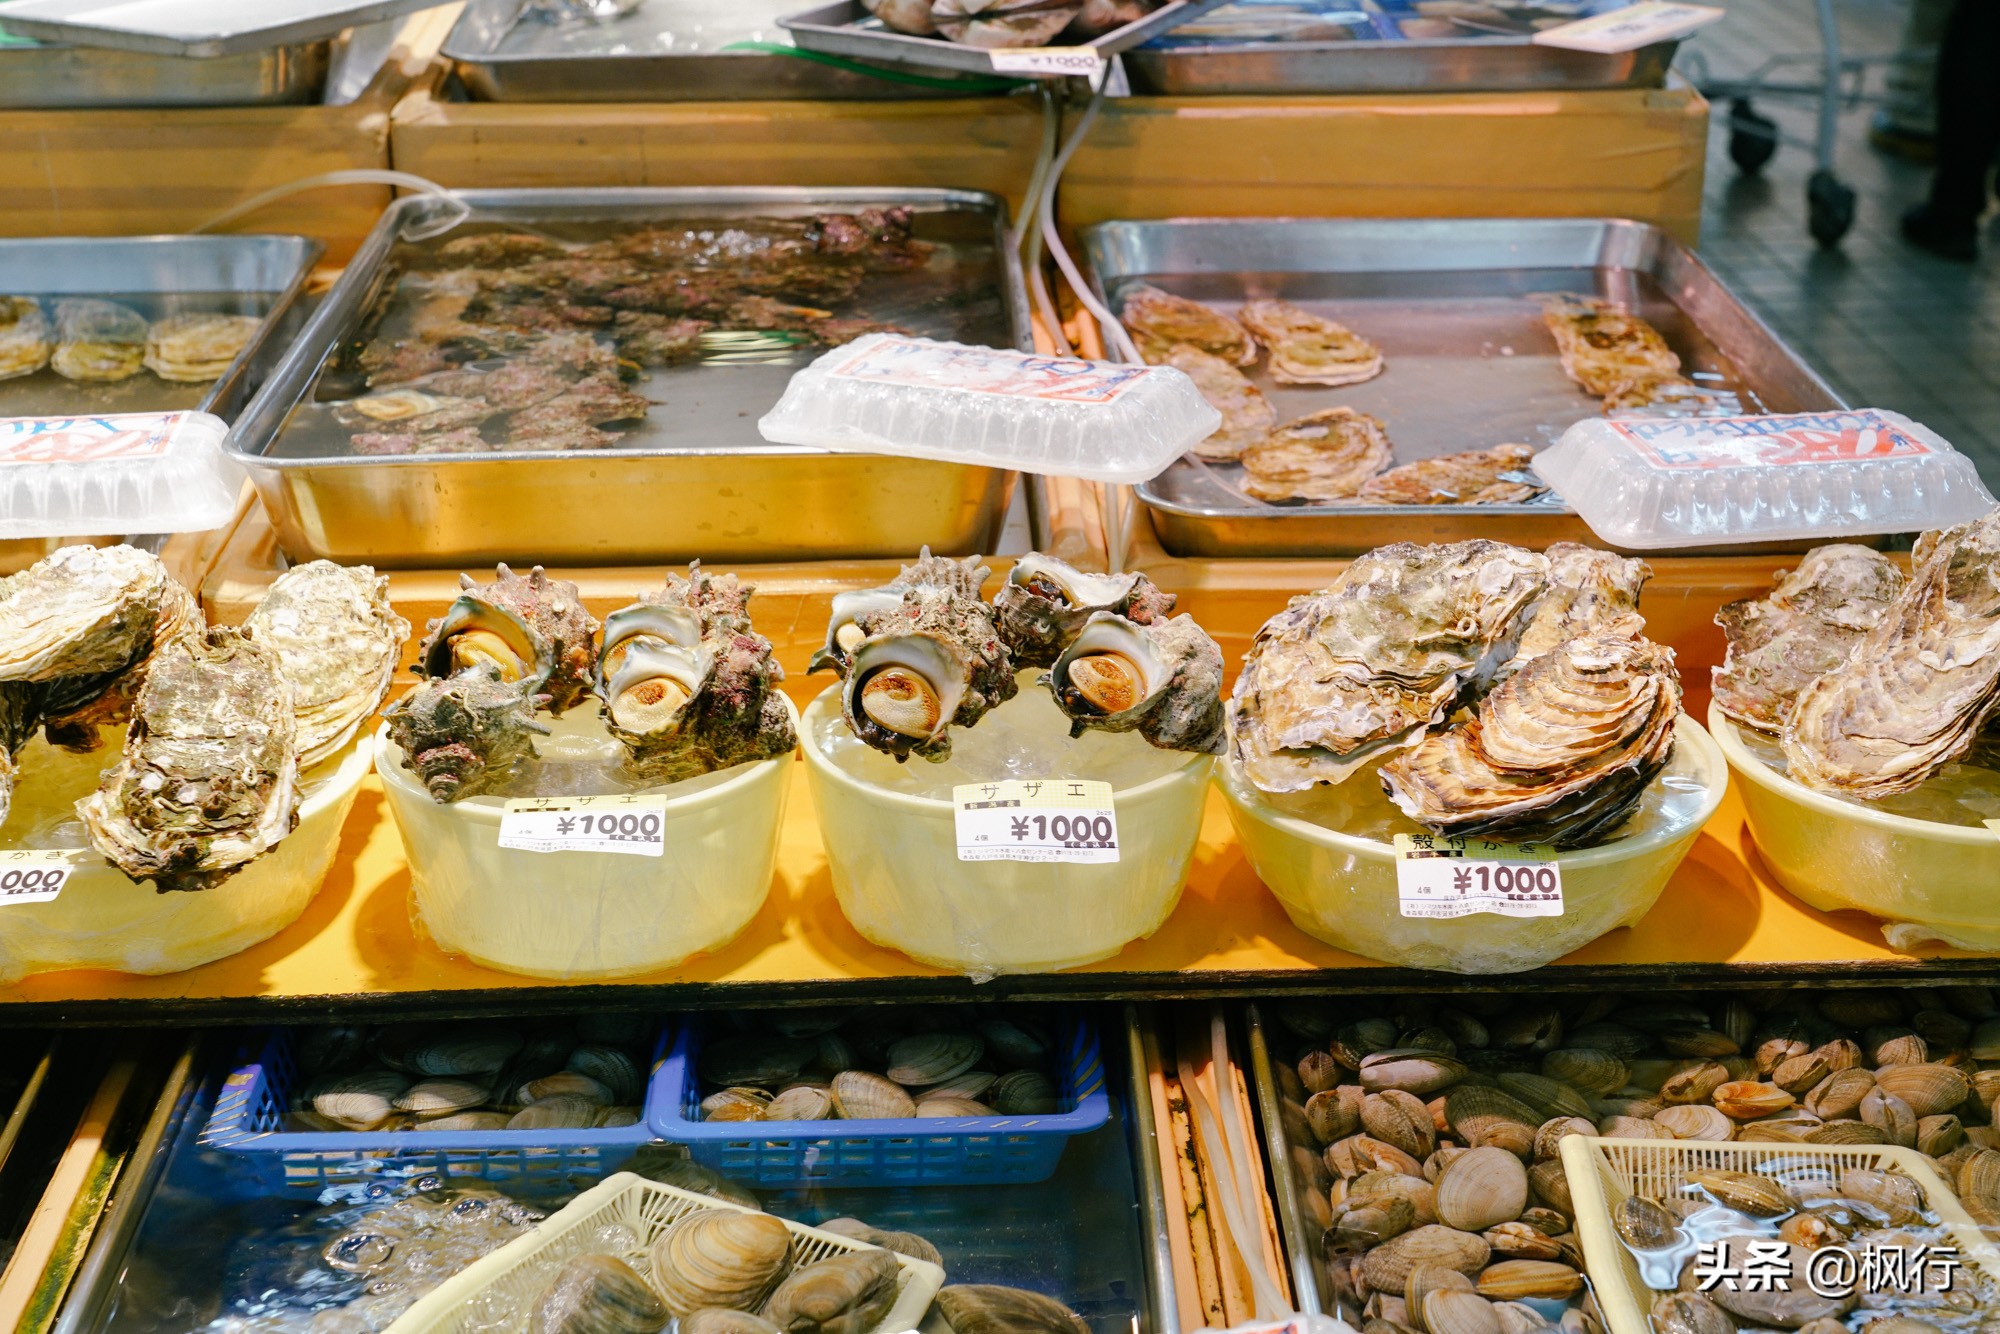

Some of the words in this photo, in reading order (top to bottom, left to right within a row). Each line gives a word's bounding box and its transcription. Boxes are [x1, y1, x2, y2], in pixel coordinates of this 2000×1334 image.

[981, 781, 1086, 799] サザエ
[533, 795, 638, 808] サザエ
[556, 813, 661, 836] ¥1000
[1011, 814, 1113, 842] ¥1000
[1411, 832, 1536, 854] 殻付かき
[1417, 886, 1432, 895] 4個
[1453, 866, 1557, 894] ¥1000
